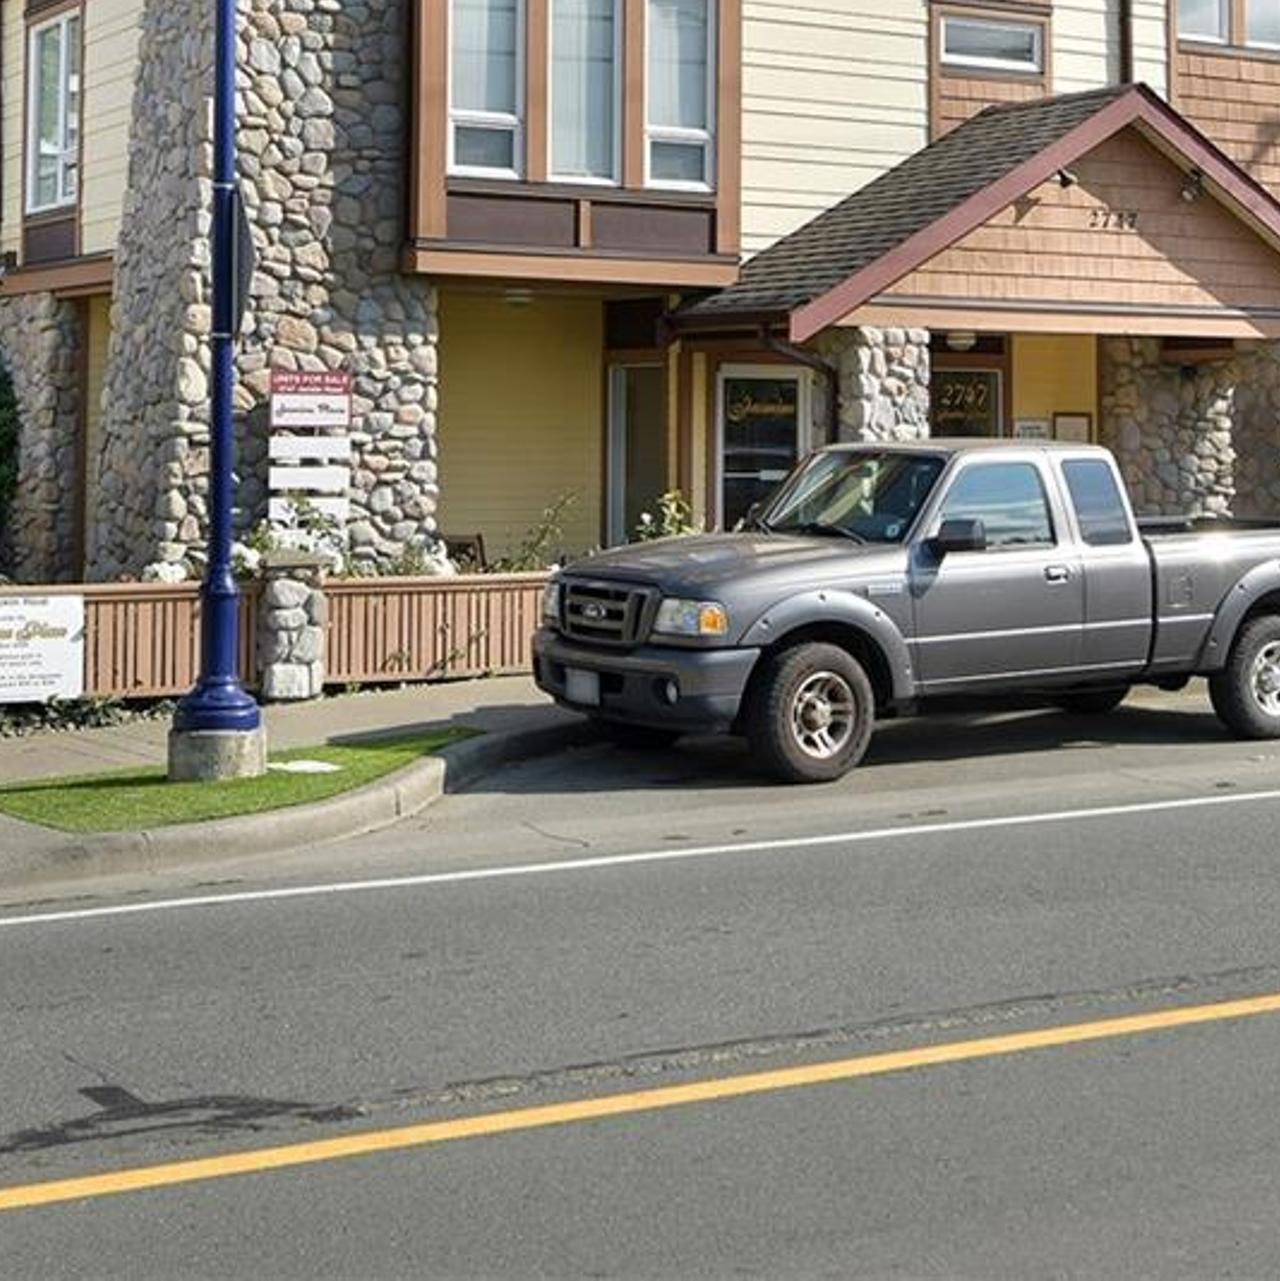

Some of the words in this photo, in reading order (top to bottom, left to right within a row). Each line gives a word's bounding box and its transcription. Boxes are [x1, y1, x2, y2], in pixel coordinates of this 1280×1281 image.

[272, 374, 300, 384] UNITS
[302, 374, 322, 384] FOR
[324, 374, 348, 384] SALE
